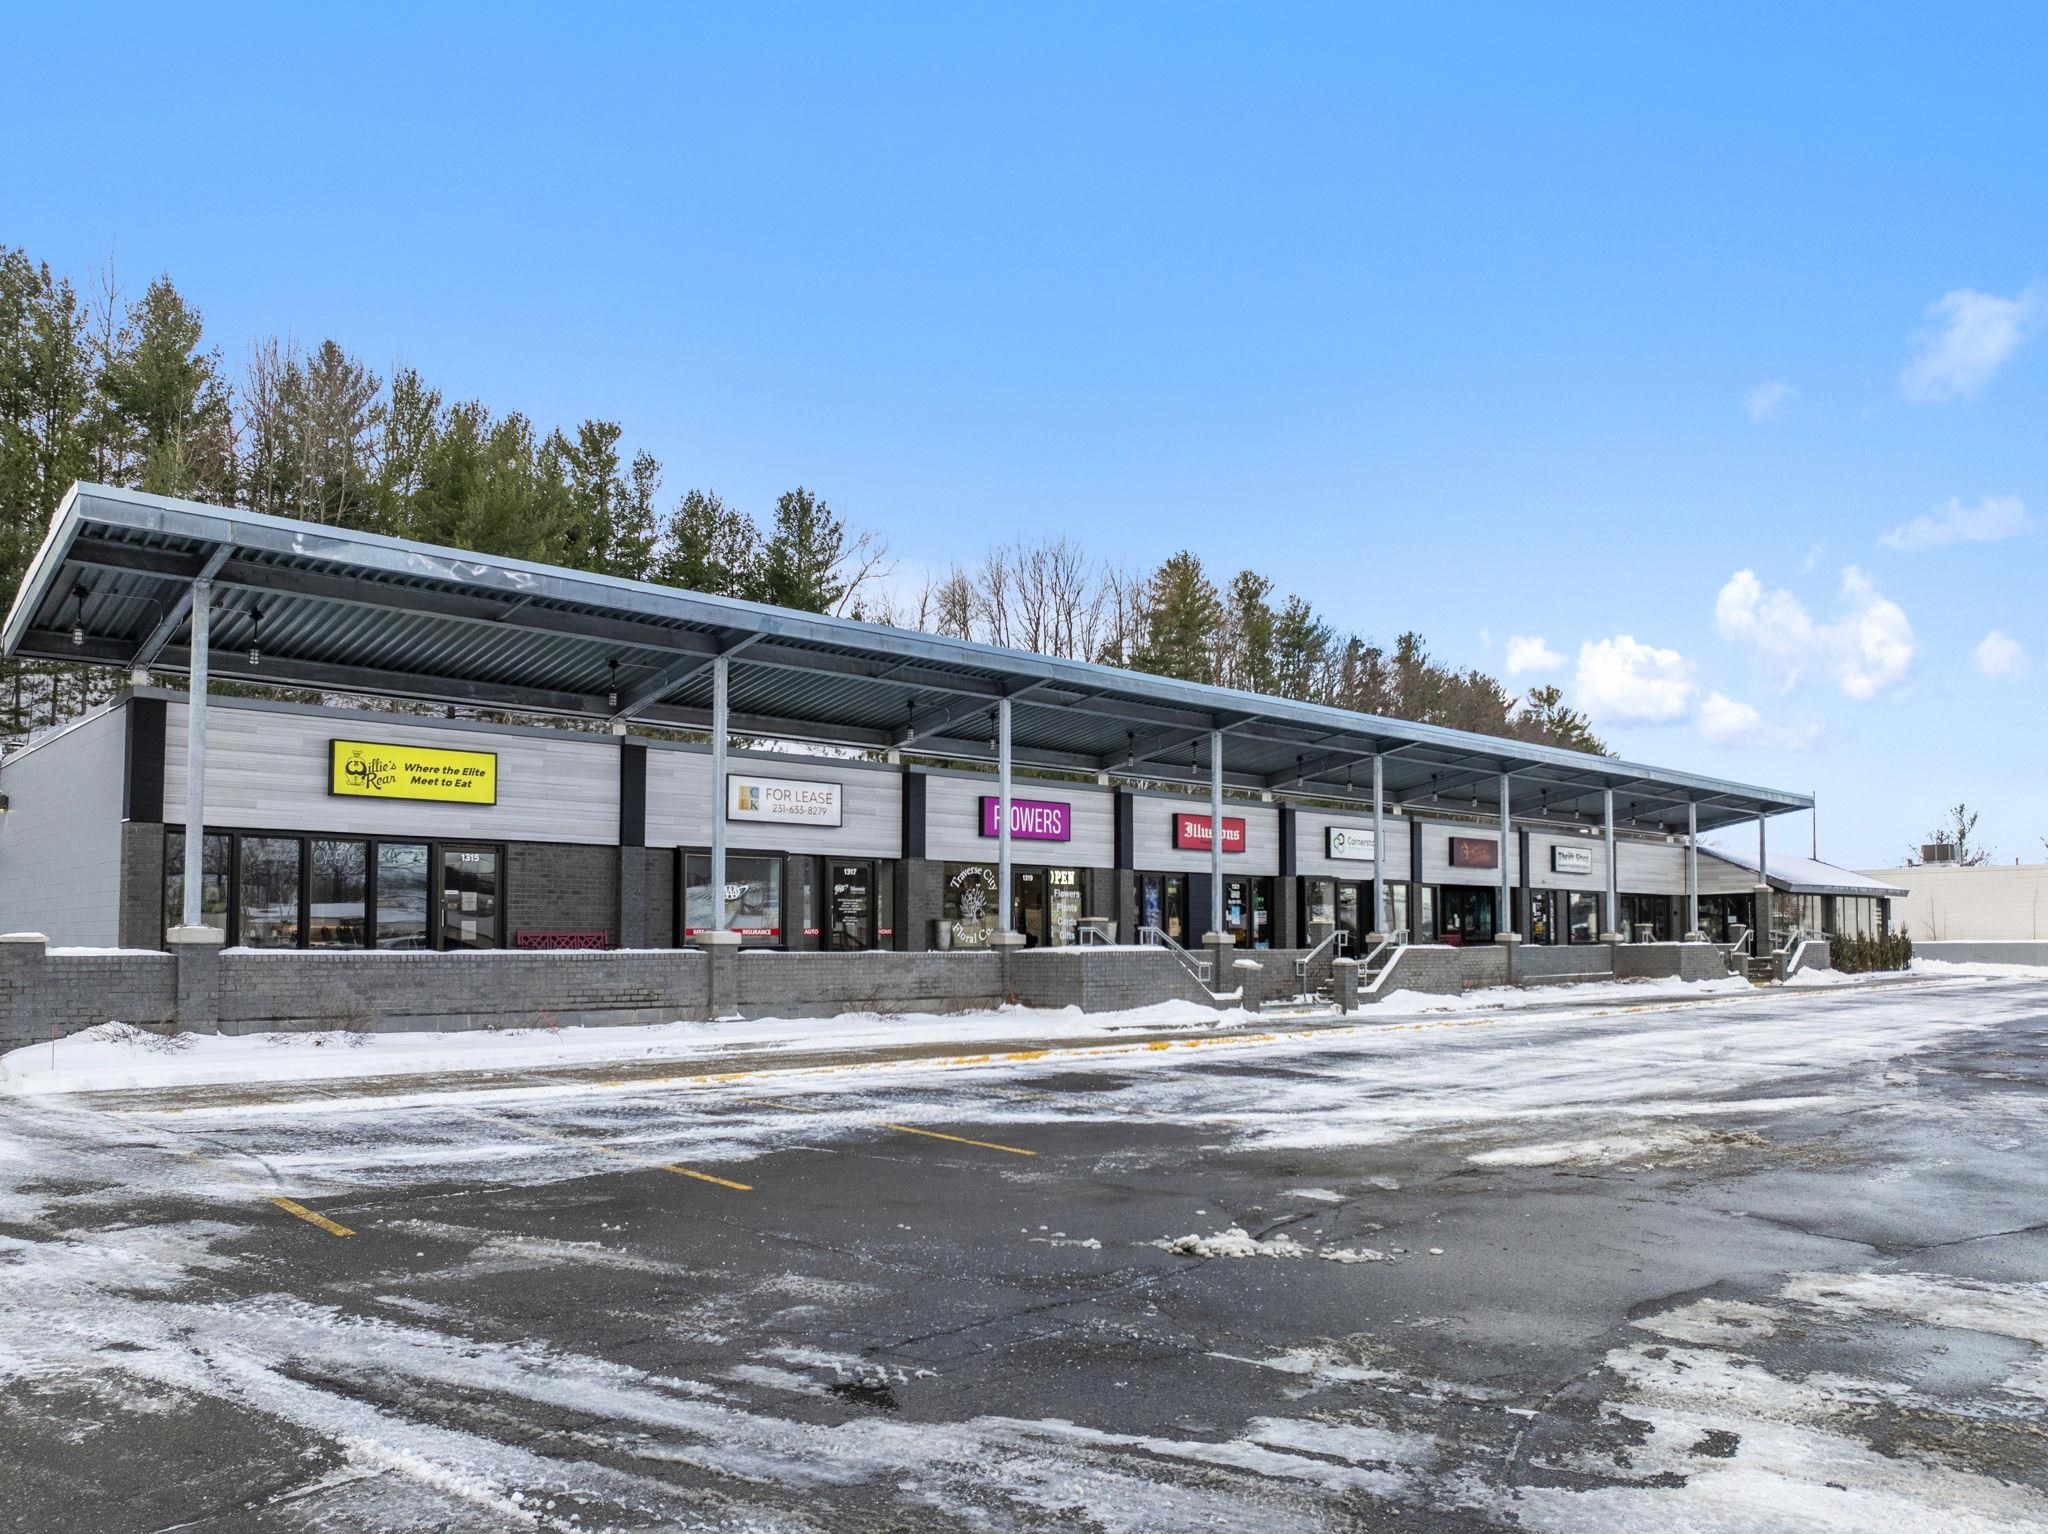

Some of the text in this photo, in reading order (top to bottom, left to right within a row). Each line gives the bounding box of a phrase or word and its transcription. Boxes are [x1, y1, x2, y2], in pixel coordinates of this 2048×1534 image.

[404, 763, 486, 777] Where the Elite
[365, 773, 396, 790] Rear
[410, 776, 472, 788] Meet to Eat
[766, 788, 833, 805] FOR LEASE
[772, 803, 827, 816] 231-633-8279
[994, 804, 1062, 834] FOWERS
[1184, 821, 1240, 840] Illusons
[460, 853, 480, 862] 1315
[843, 868, 857, 876] 1317
[950, 866, 998, 890] Traverse City
[1053, 889, 1081, 898] Flowers
[1056, 903, 1078, 912] Plants
[952, 922, 994, 943] Floral Co.
[1059, 930, 1076, 940] Gifts
